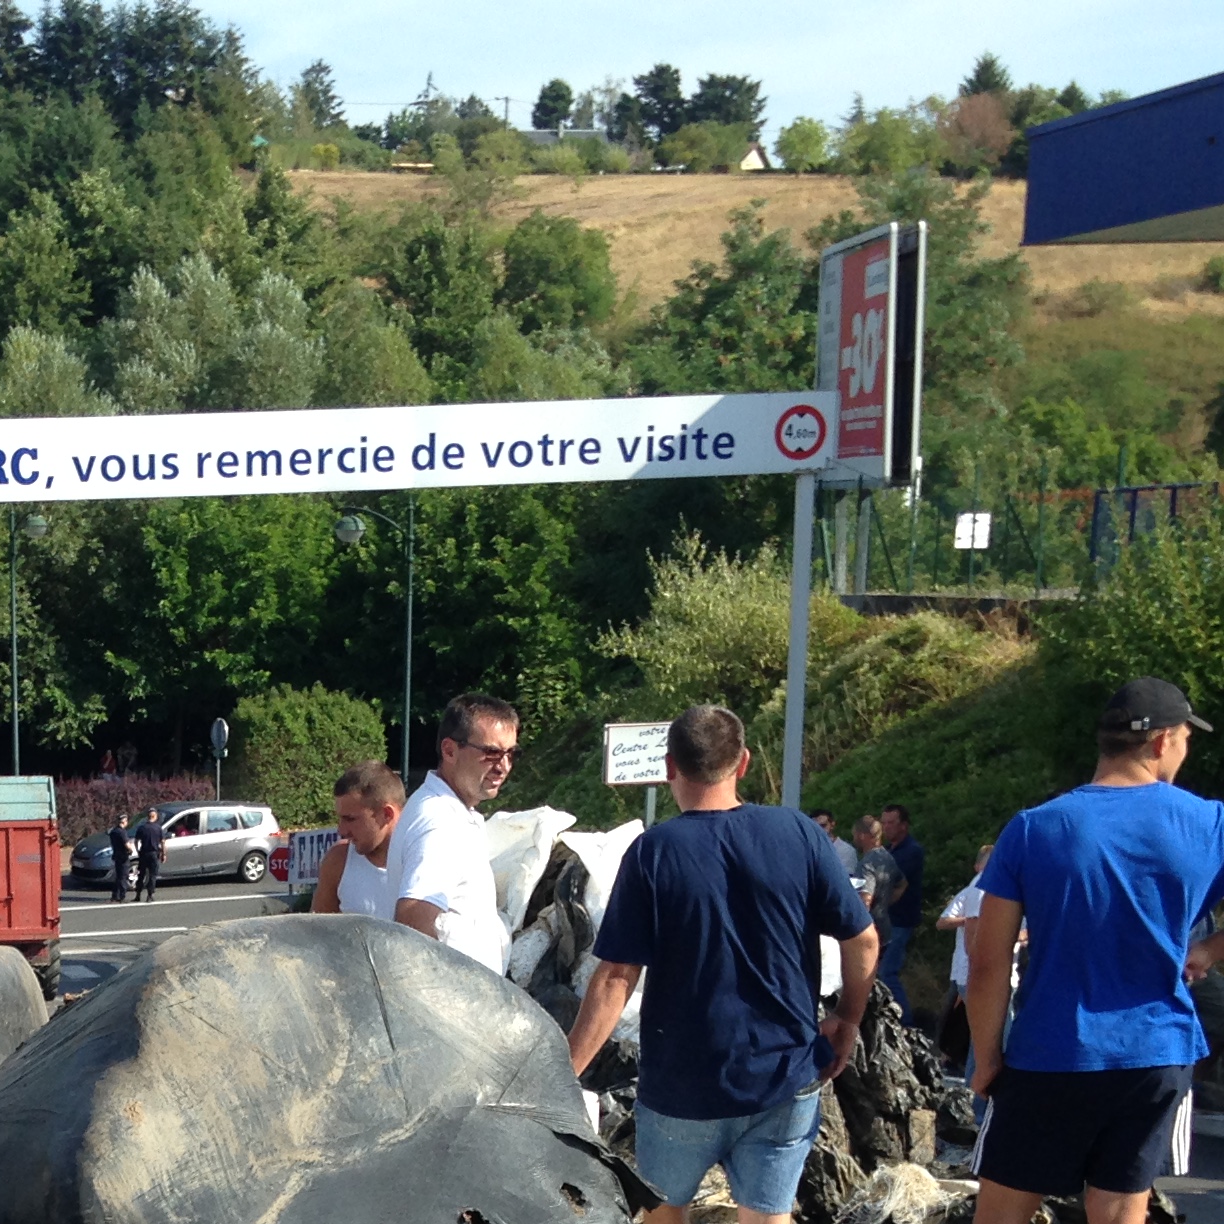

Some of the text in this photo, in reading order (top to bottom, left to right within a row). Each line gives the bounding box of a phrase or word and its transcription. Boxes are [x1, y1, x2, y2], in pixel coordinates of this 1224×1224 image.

[73, 453, 180, 482] vous
[197, 437, 395, 479] remercie
[411, 432, 465, 471] de
[481, 434, 602, 468] votre
[617, 424, 736, 462] visite
[638, 727, 666, 737] votre
[612, 743, 648, 757] Centre
[615, 758, 640, 767] vous
[614, 768, 660, 782] de votre
[271, 858, 289, 870] STO
